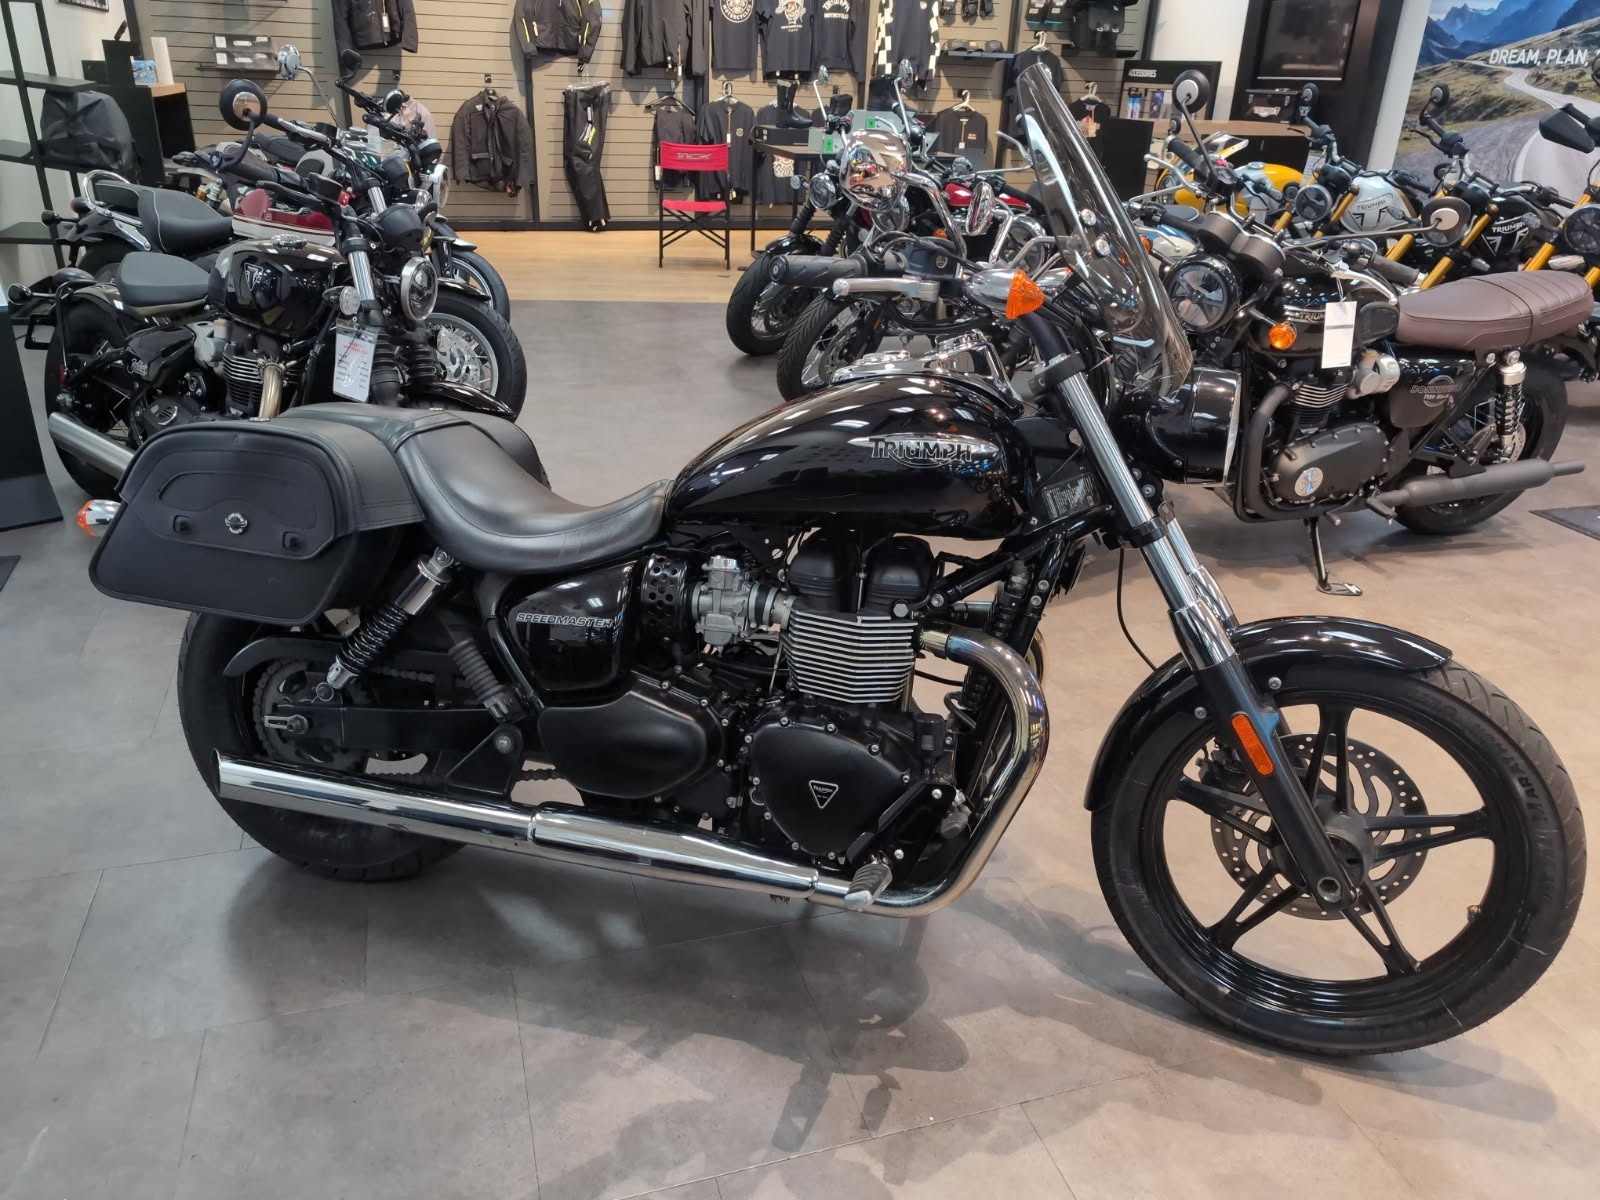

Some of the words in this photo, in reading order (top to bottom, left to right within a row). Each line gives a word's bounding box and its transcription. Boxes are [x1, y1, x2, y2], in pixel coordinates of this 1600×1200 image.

[1489, 49, 1540, 66] DREAM,
[1545, 49, 1589, 66] PLAN,
[1356, 199, 1387, 211] TRIUMPH
[1300, 311, 1326, 320] TRIUM
[1410, 384, 1463, 394] BONNEV
[868, 437, 972, 464] TRIUMPH
[515, 612, 613, 628] SPEEDMASTER
